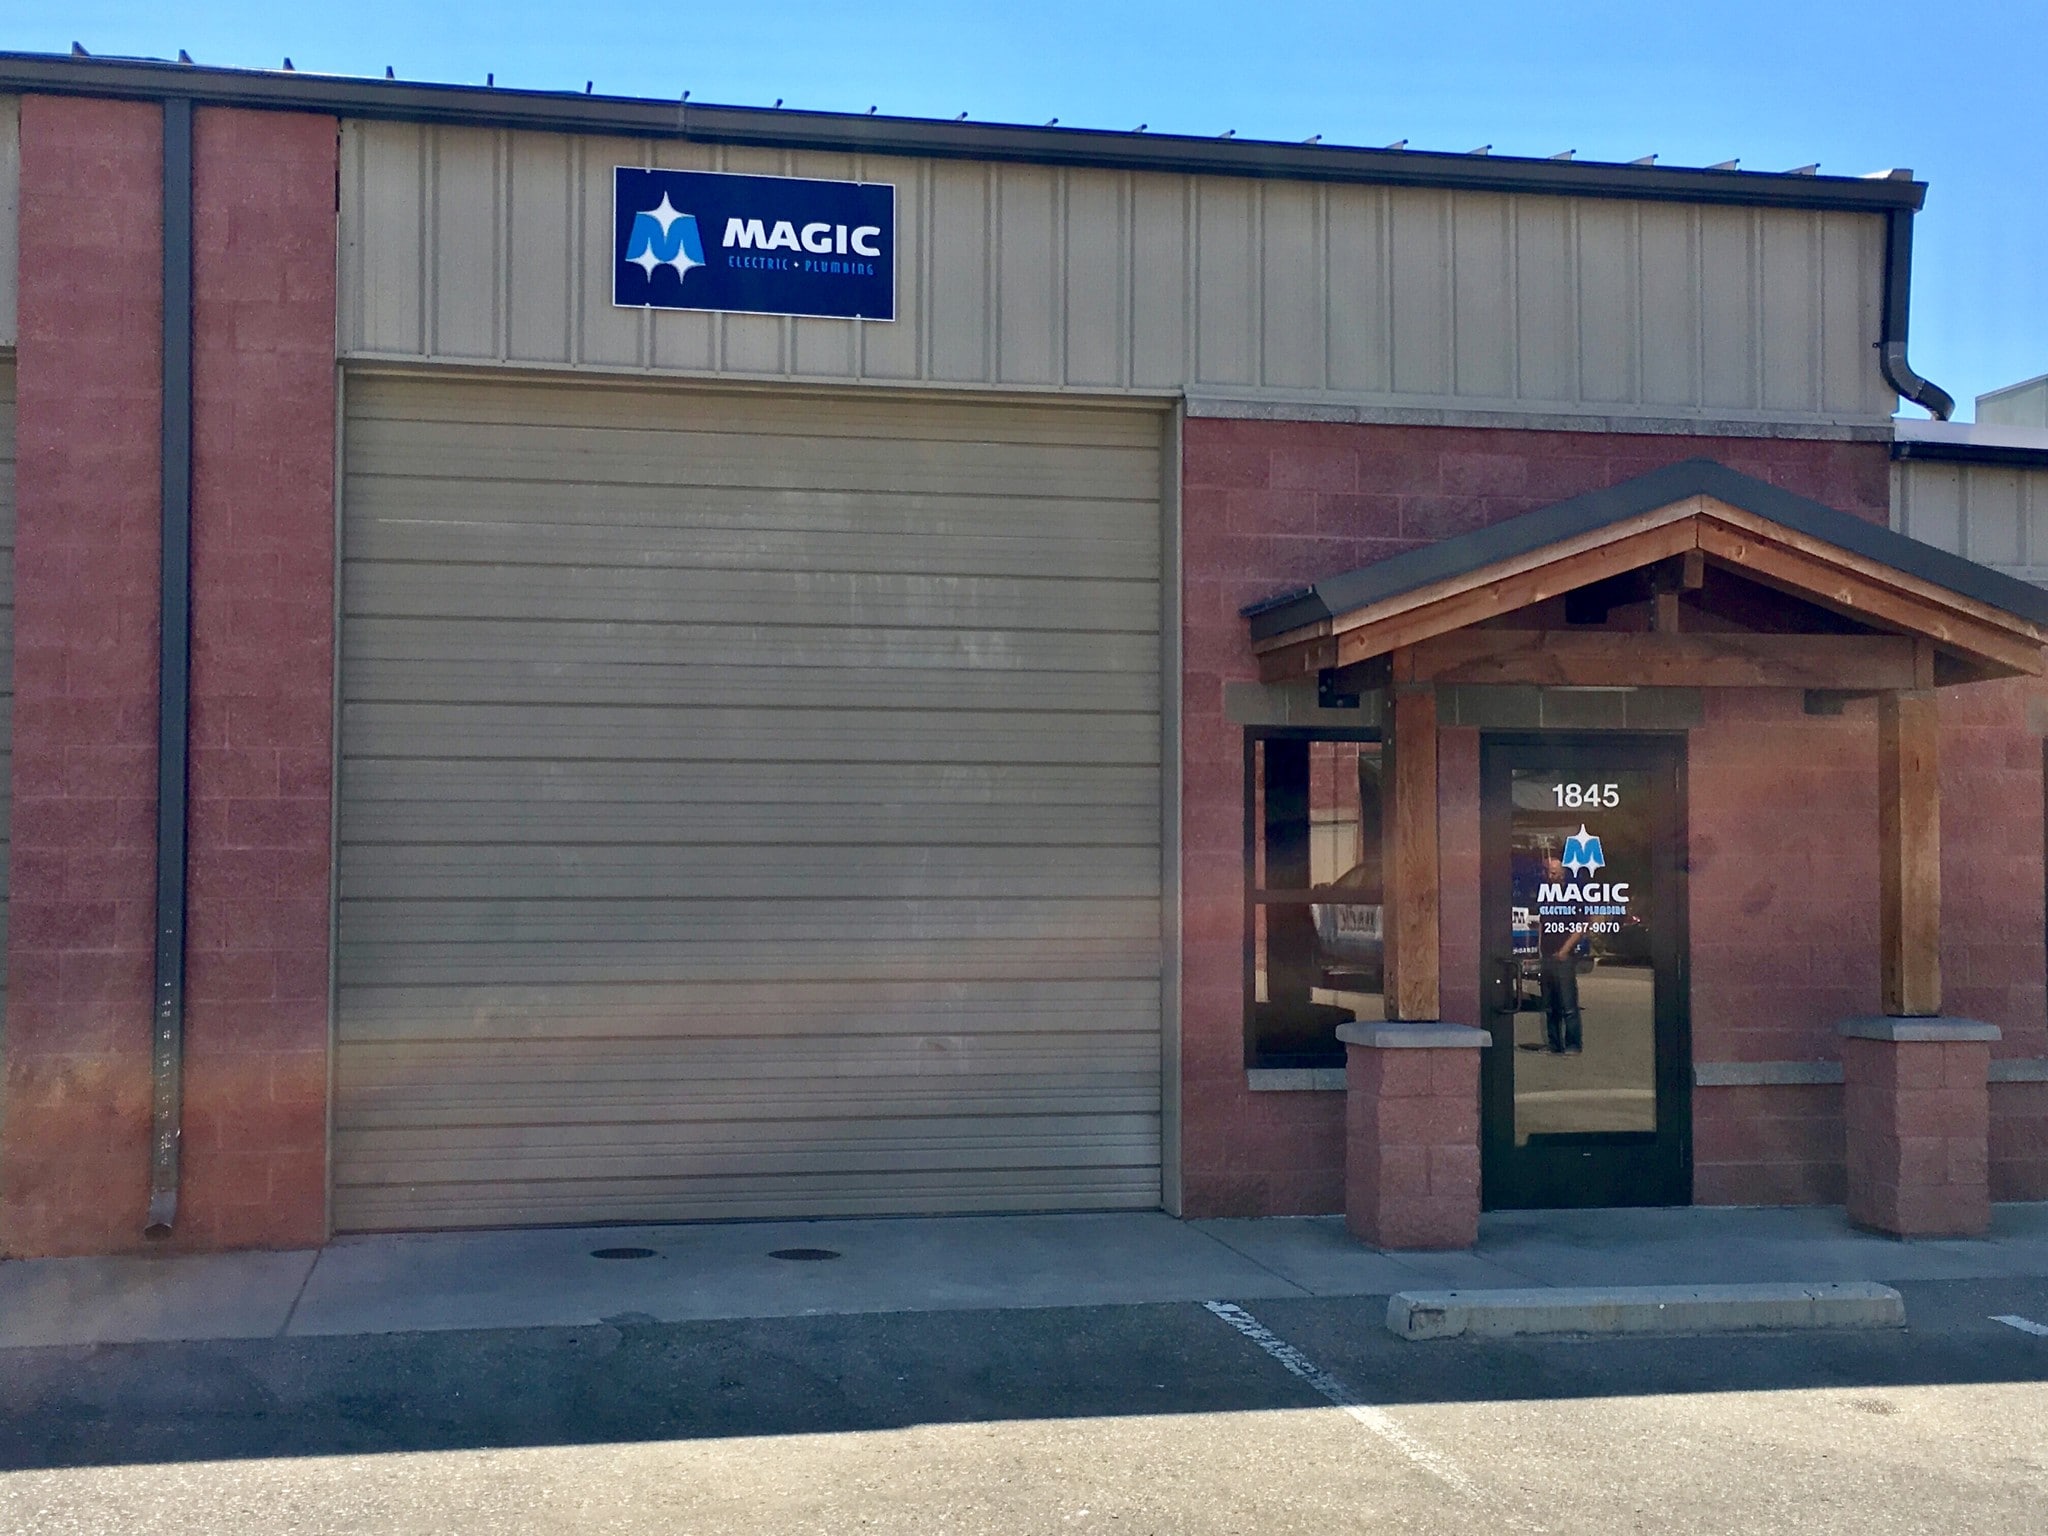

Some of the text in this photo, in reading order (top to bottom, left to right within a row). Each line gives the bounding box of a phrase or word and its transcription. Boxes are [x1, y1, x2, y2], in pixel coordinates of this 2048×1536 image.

[722, 217, 881, 257] MAGIC
[728, 255, 875, 276] ELECTRIC PLUMBING
[1552, 783, 1620, 808] 1845
[1537, 883, 1630, 903] MAGIC
[1539, 905, 1627, 916] ELECTRIC PLUMBING
[1544, 922, 1620, 934] 208-367-9070
